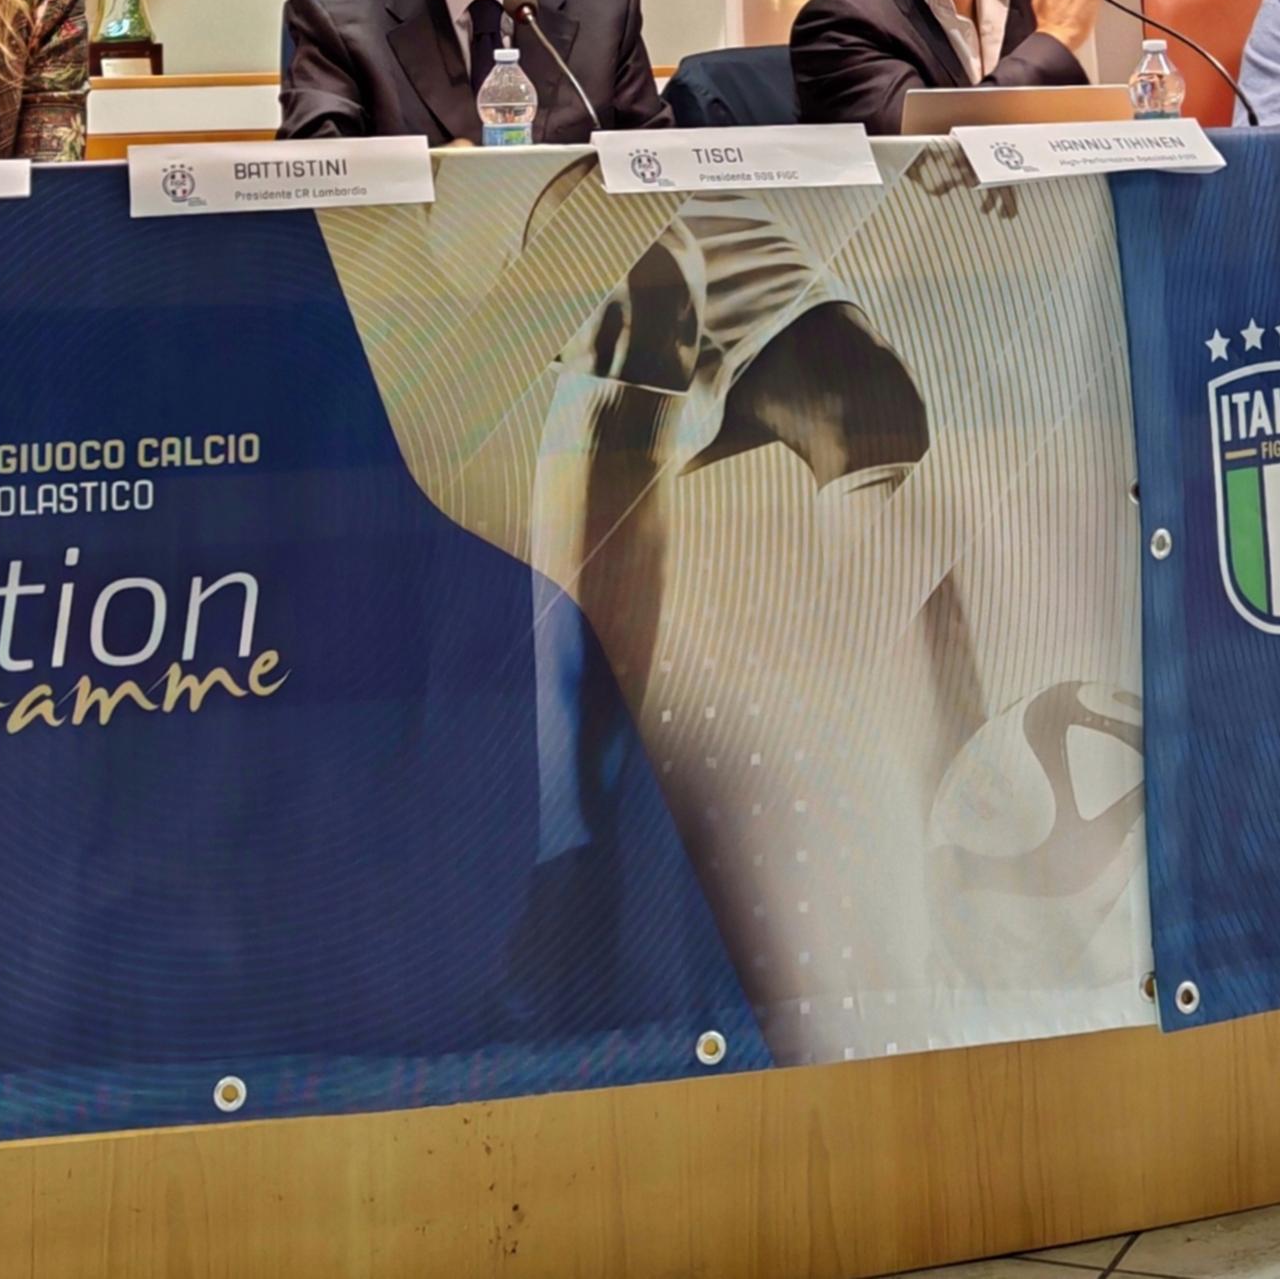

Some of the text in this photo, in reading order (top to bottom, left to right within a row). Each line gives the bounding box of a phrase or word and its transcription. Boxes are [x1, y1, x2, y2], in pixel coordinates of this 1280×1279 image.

[1048, 136, 1186, 153] HANNU TIHINEN
[691, 147, 744, 165] TISCI
[234, 158, 348, 180] BATTISTINI
[234, 185, 368, 202] Presidente CR Lombardia
[136, 433, 261, 468] CALCIO
